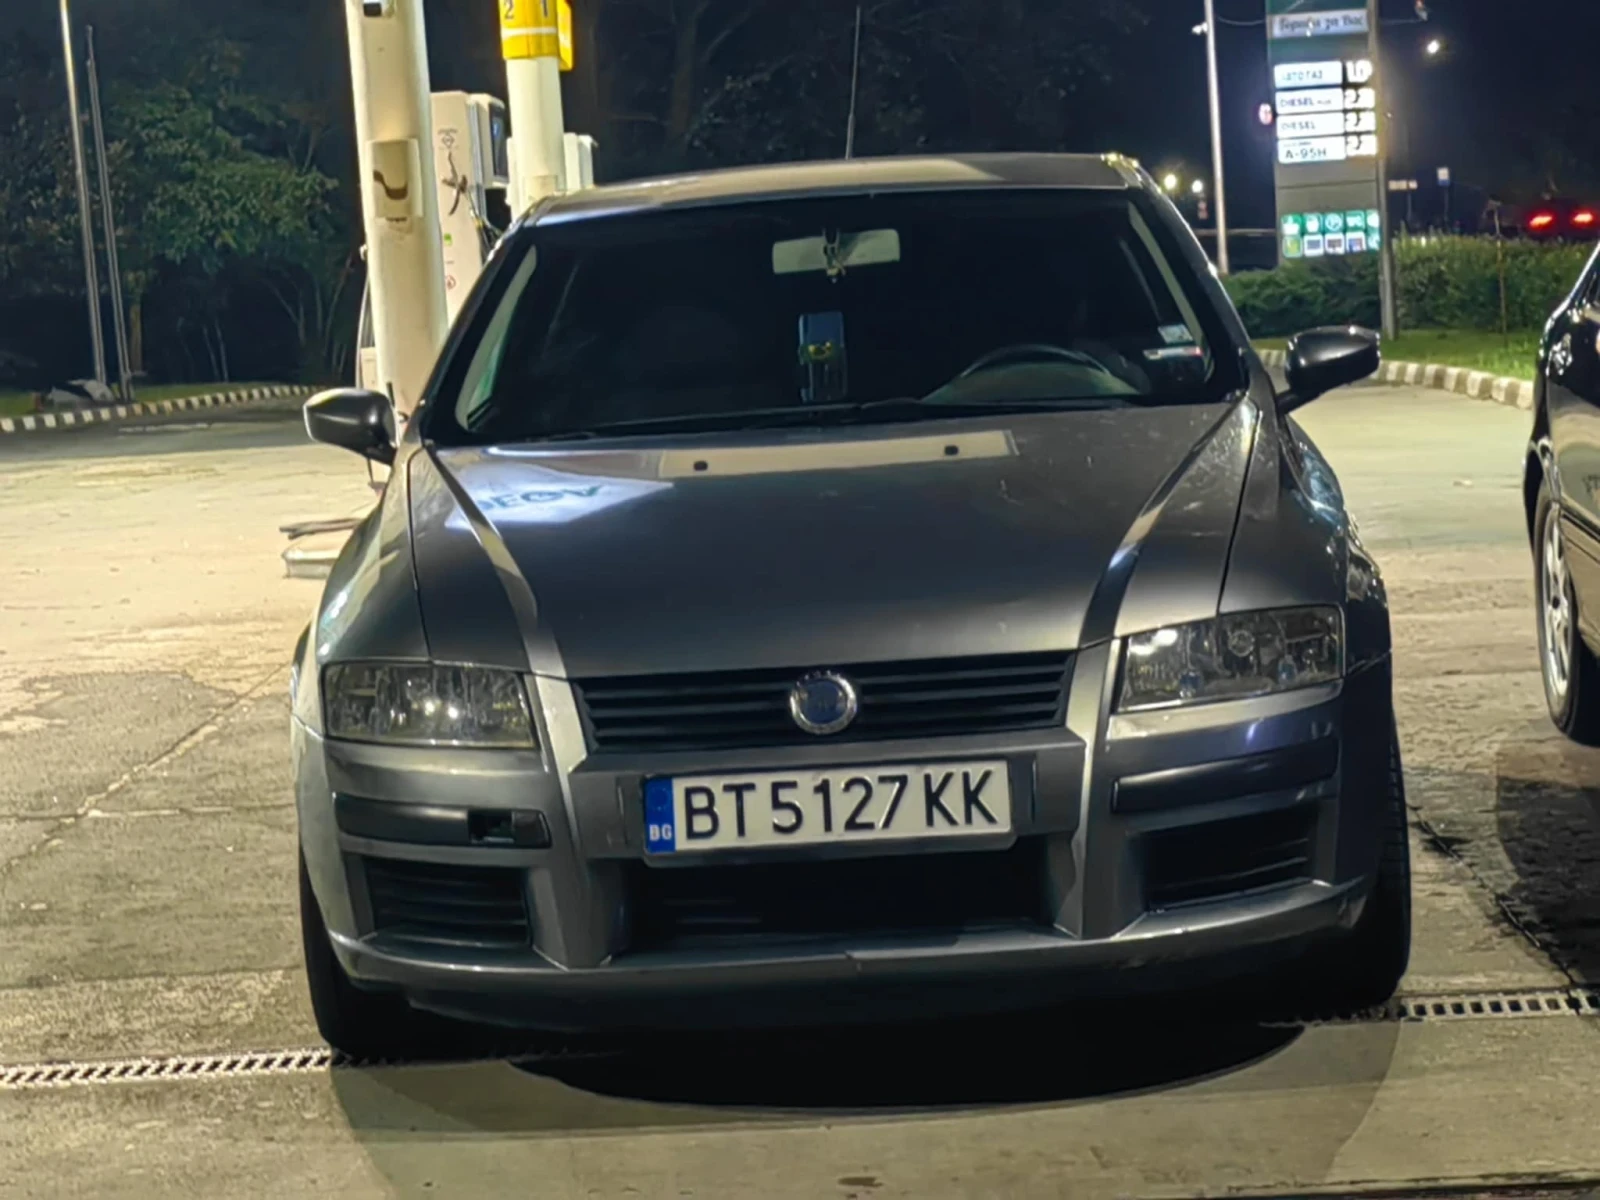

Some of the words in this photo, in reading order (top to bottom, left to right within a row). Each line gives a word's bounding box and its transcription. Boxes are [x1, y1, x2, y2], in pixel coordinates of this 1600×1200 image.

[503, 0, 514, 19] 2
[1279, 97, 1314, 107] DIESEL
[1281, 121, 1316, 130] DIESEL
[683, 782, 755, 840] BT
[771, 773, 909, 834] 5127
[923, 769, 999, 827] KK
[649, 823, 672, 842] BG
